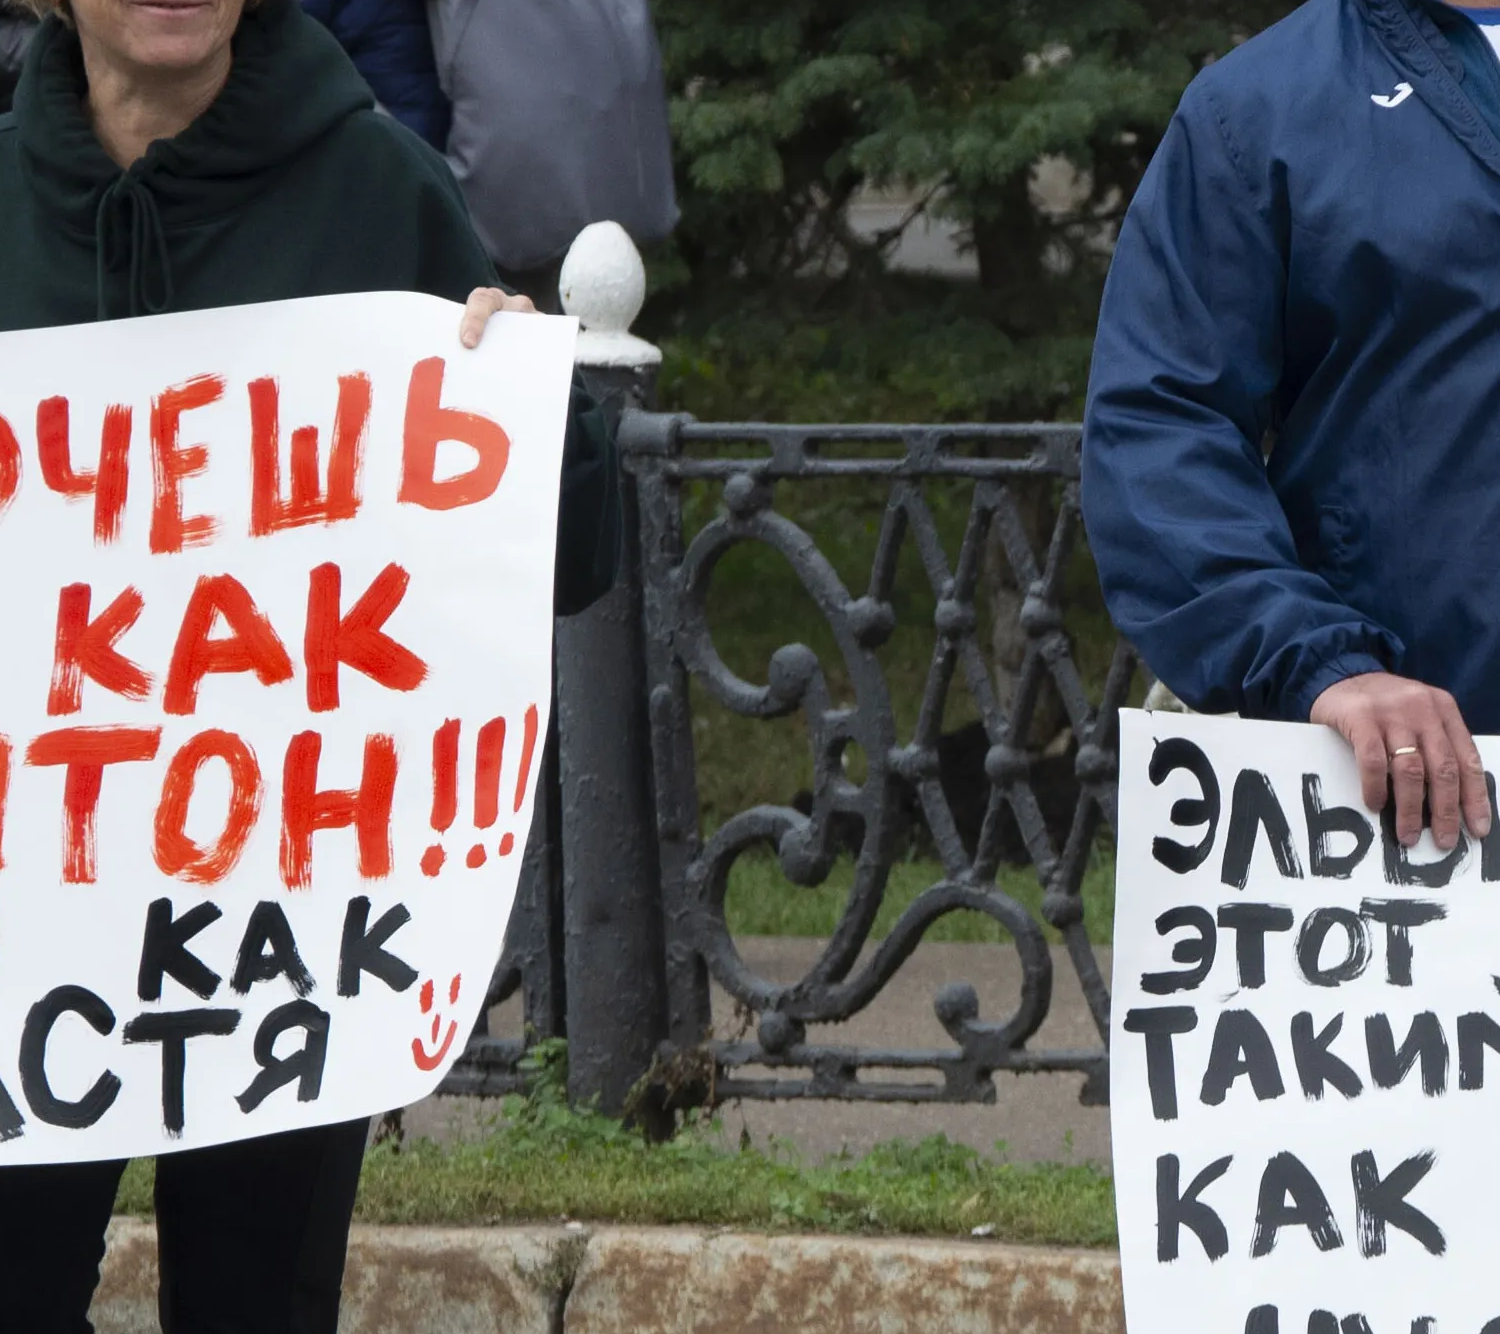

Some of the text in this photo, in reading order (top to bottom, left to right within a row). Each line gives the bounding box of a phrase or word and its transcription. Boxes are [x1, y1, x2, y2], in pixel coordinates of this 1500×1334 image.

[47, 561, 428, 717] КАК
[138, 894, 420, 1000] КАК
[1140, 898, 1450, 997] ЭТОТ
[1154, 1148, 1447, 1263] КАК
